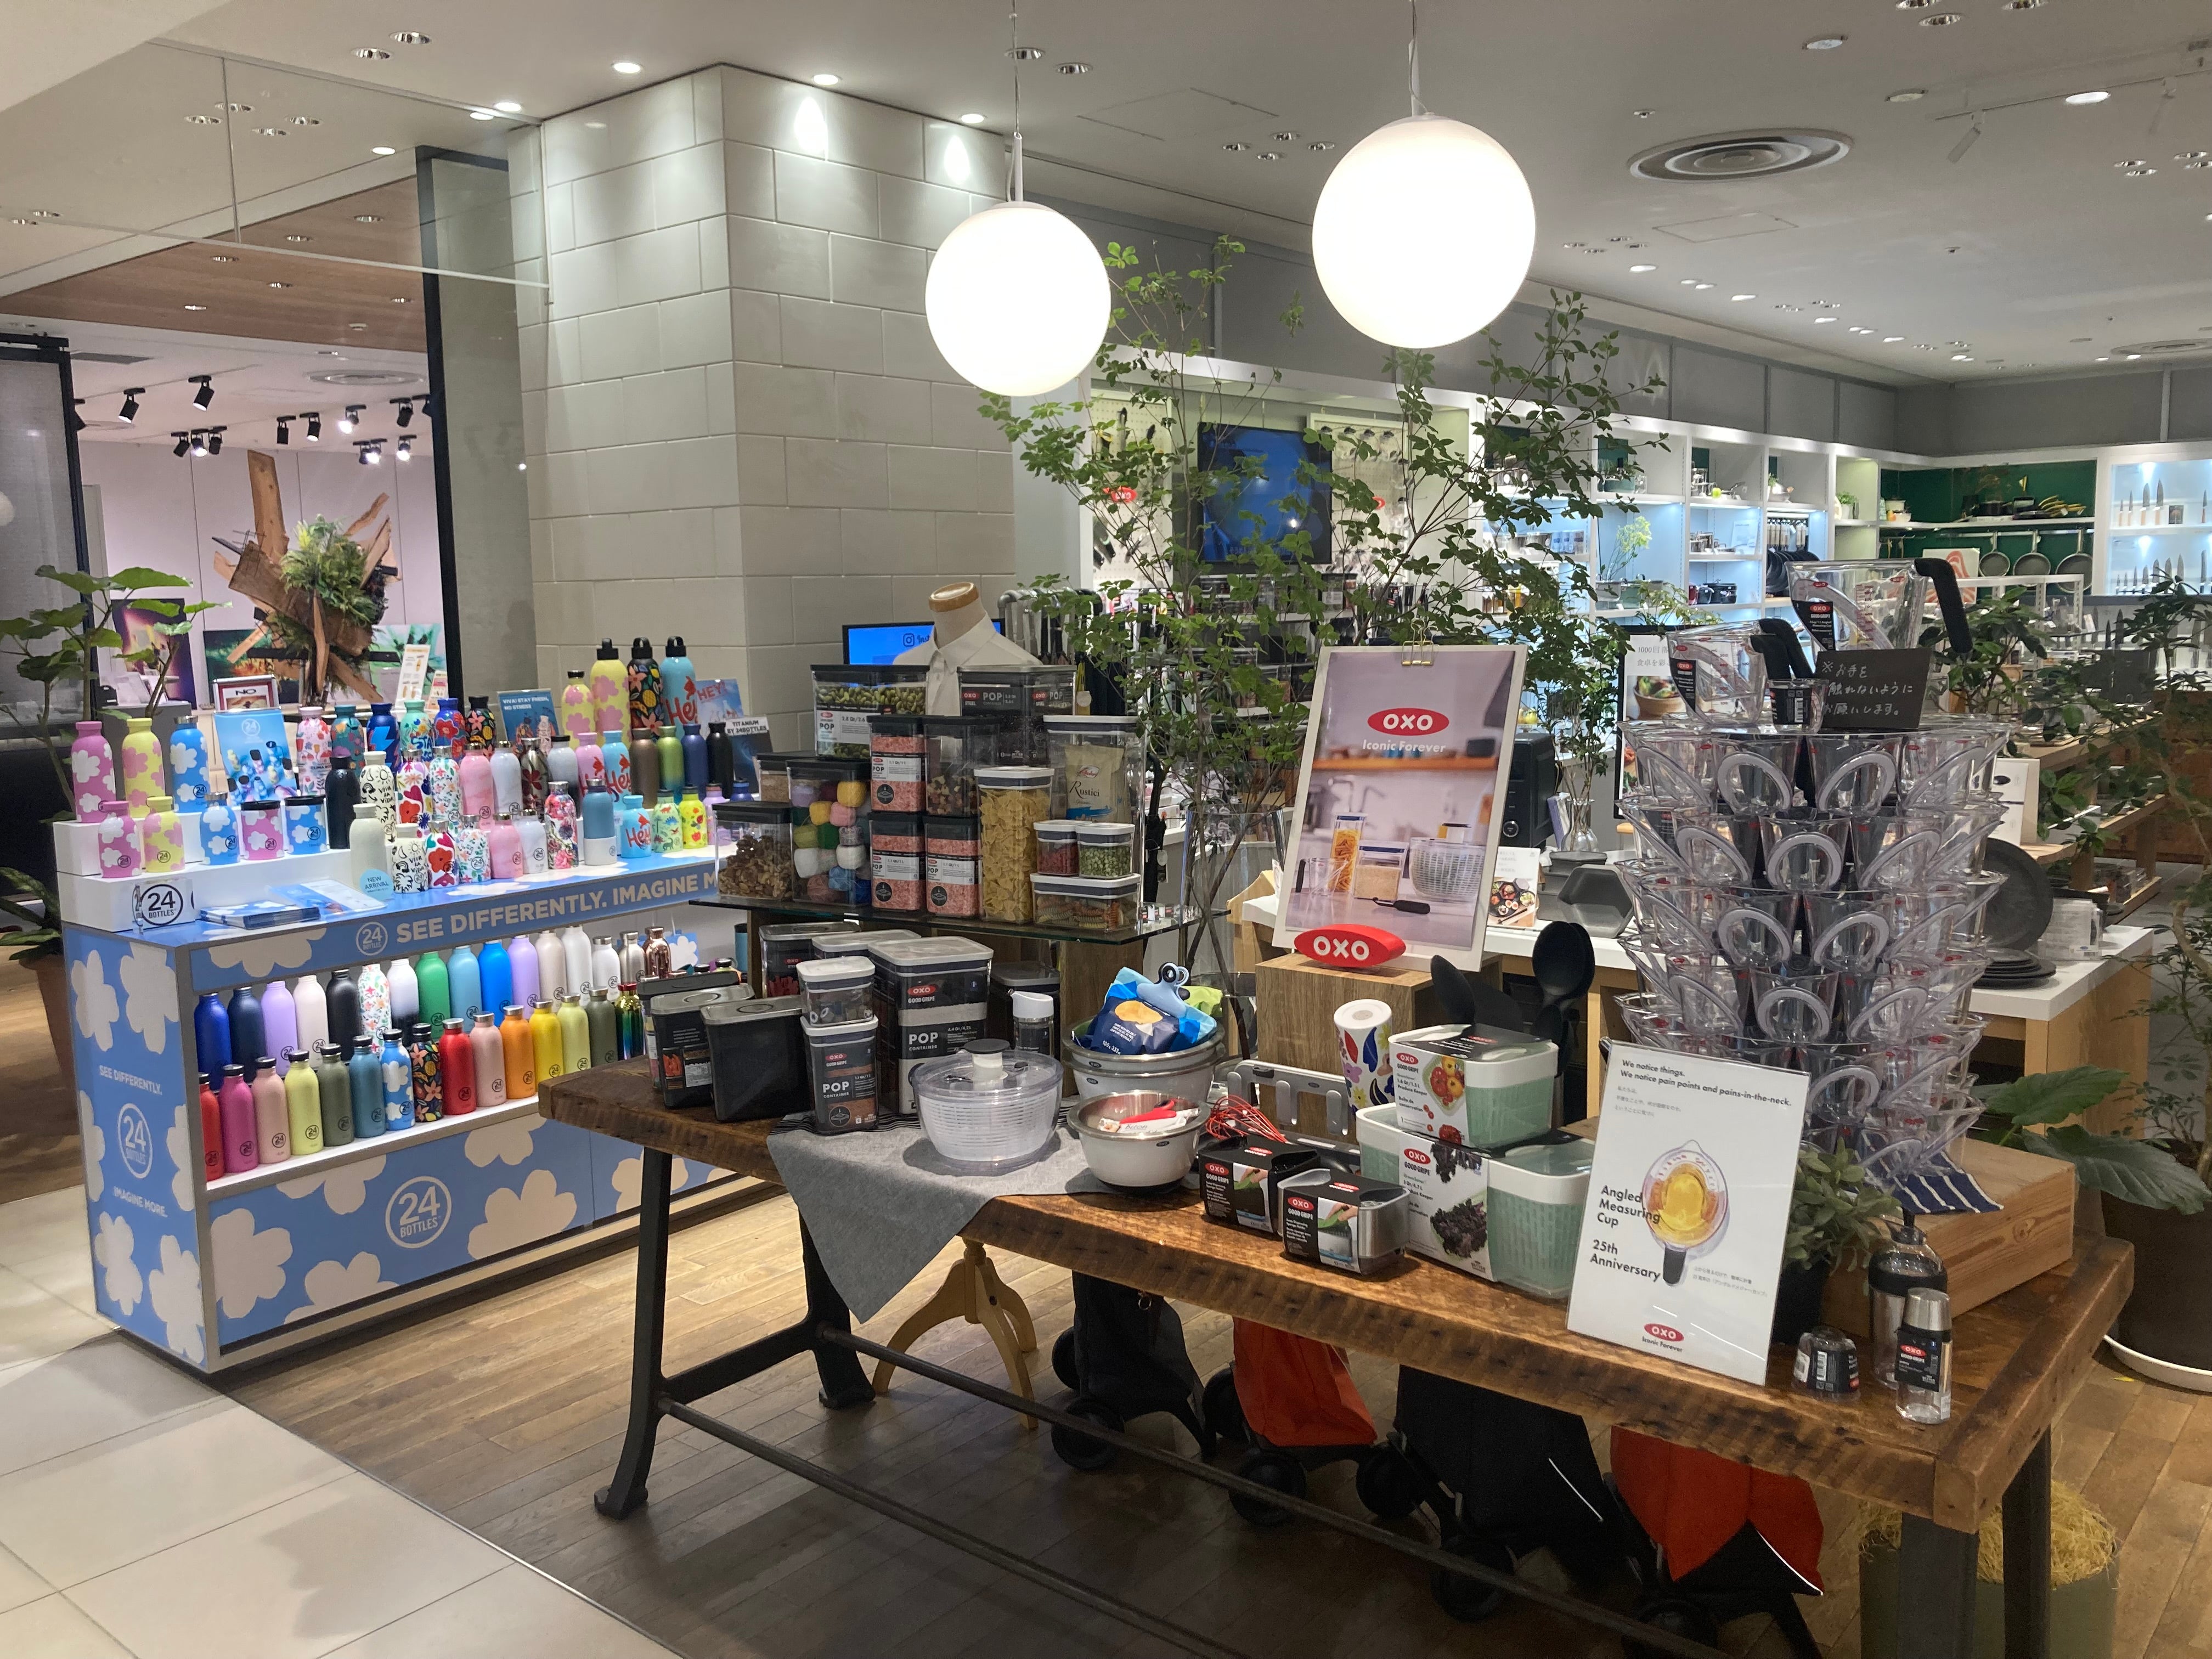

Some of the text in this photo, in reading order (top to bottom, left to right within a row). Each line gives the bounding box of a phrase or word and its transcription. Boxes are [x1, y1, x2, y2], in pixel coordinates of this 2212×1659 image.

[983, 692, 1002, 701] POP
[1049, 691, 1063, 700] POP
[1828, 681, 1913, 696] 触れないように
[1383, 714, 1433, 731] OXO
[1362, 740, 1446, 753] Iconic Forever
[1069, 781, 1099, 799] Rustici
[365, 882, 389, 890] ARRIVAL
[148, 890, 176, 912] 24
[397, 917, 444, 943] SEE
[450, 891, 606, 934] DIFFERENTLY.
[612, 874, 698, 905] IMAGINE
[148, 909, 174, 919] BOTTLES
[362, 927, 382, 944] 24
[1313, 935, 1369, 961] OXO
[909, 1032, 939, 1045] POP
[1400, 1054, 1414, 1063] OXO
[1622, 1059, 1685, 1077] We notice things.
[99, 1065, 162, 1096] SEE DIFFERENTLY.
[823, 1081, 849, 1093] POP
[1621, 1070, 1792, 1106] We notice pain points and pains-in-the-neck.
[123, 1115, 146, 1152] 24
[1408, 1152, 1425, 1162] OXO
[1209, 1164, 1224, 1173] OXO
[1404, 1161, 1430, 1176] GOOD GRIPS
[1206, 1173, 1217, 1181] GOOD
[114, 1186, 167, 1217] IMAGINE MORE.
[1601, 1185, 1643, 1203] Angled
[398, 1186, 441, 1226] 24
[1293, 1199, 1309, 1209] OXO
[1599, 1198, 1661, 1224] Measuring
[1288, 1208, 1313, 1221] GOOD GRIPS
[1597, 1212, 1618, 1229] Cup
[400, 1217, 438, 1238] BOTTLES
[1593, 1239, 1618, 1255] 25th
[1590, 1253, 1661, 1283] Anniversary
[1651, 1326, 1676, 1339] OXO
[1642, 1336, 1682, 1352] Iconic Forever
[1906, 1346, 1921, 1355] OXO
